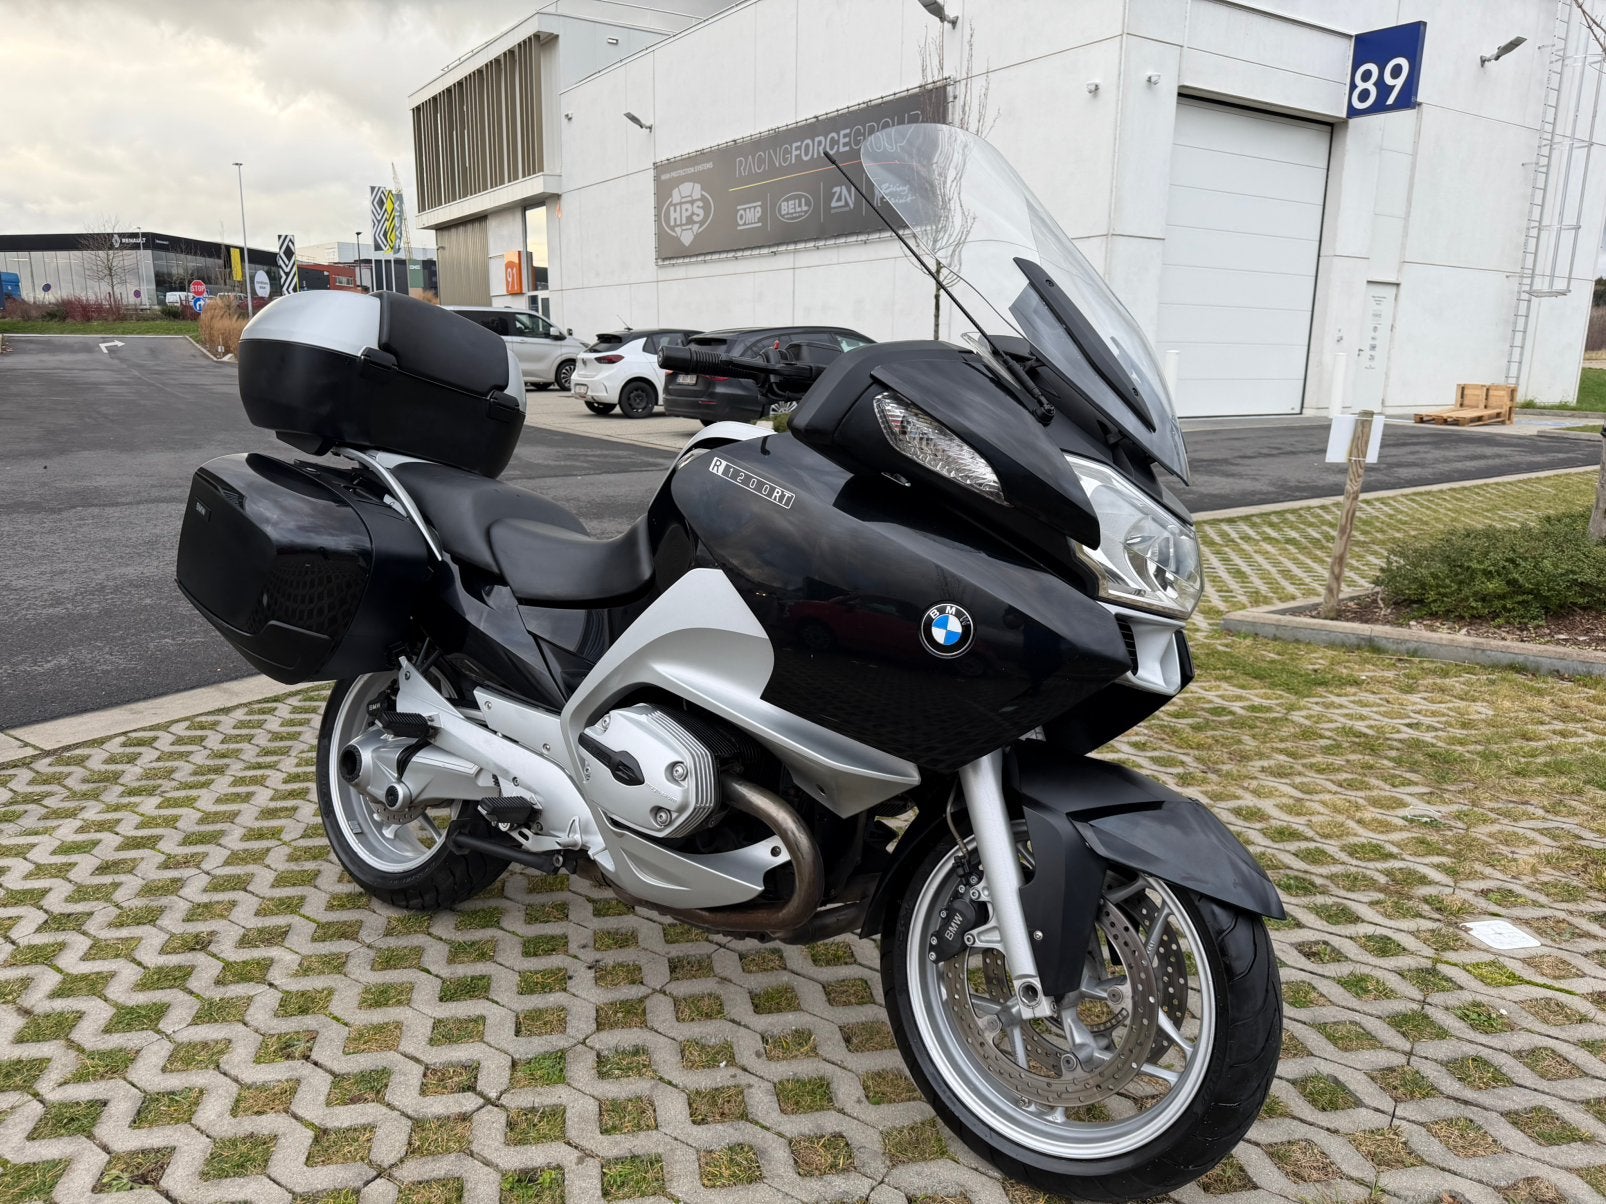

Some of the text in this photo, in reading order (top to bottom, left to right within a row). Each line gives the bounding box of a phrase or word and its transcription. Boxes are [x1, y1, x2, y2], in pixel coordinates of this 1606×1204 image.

[1351, 56, 1410, 110] 89
[669, 200, 705, 226] HPS
[736, 206, 762, 225] OMP
[780, 197, 809, 215] BELL
[506, 267, 518, 291] 91
[929, 605, 970, 626] BMW
[944, 912, 963, 941] BMW
